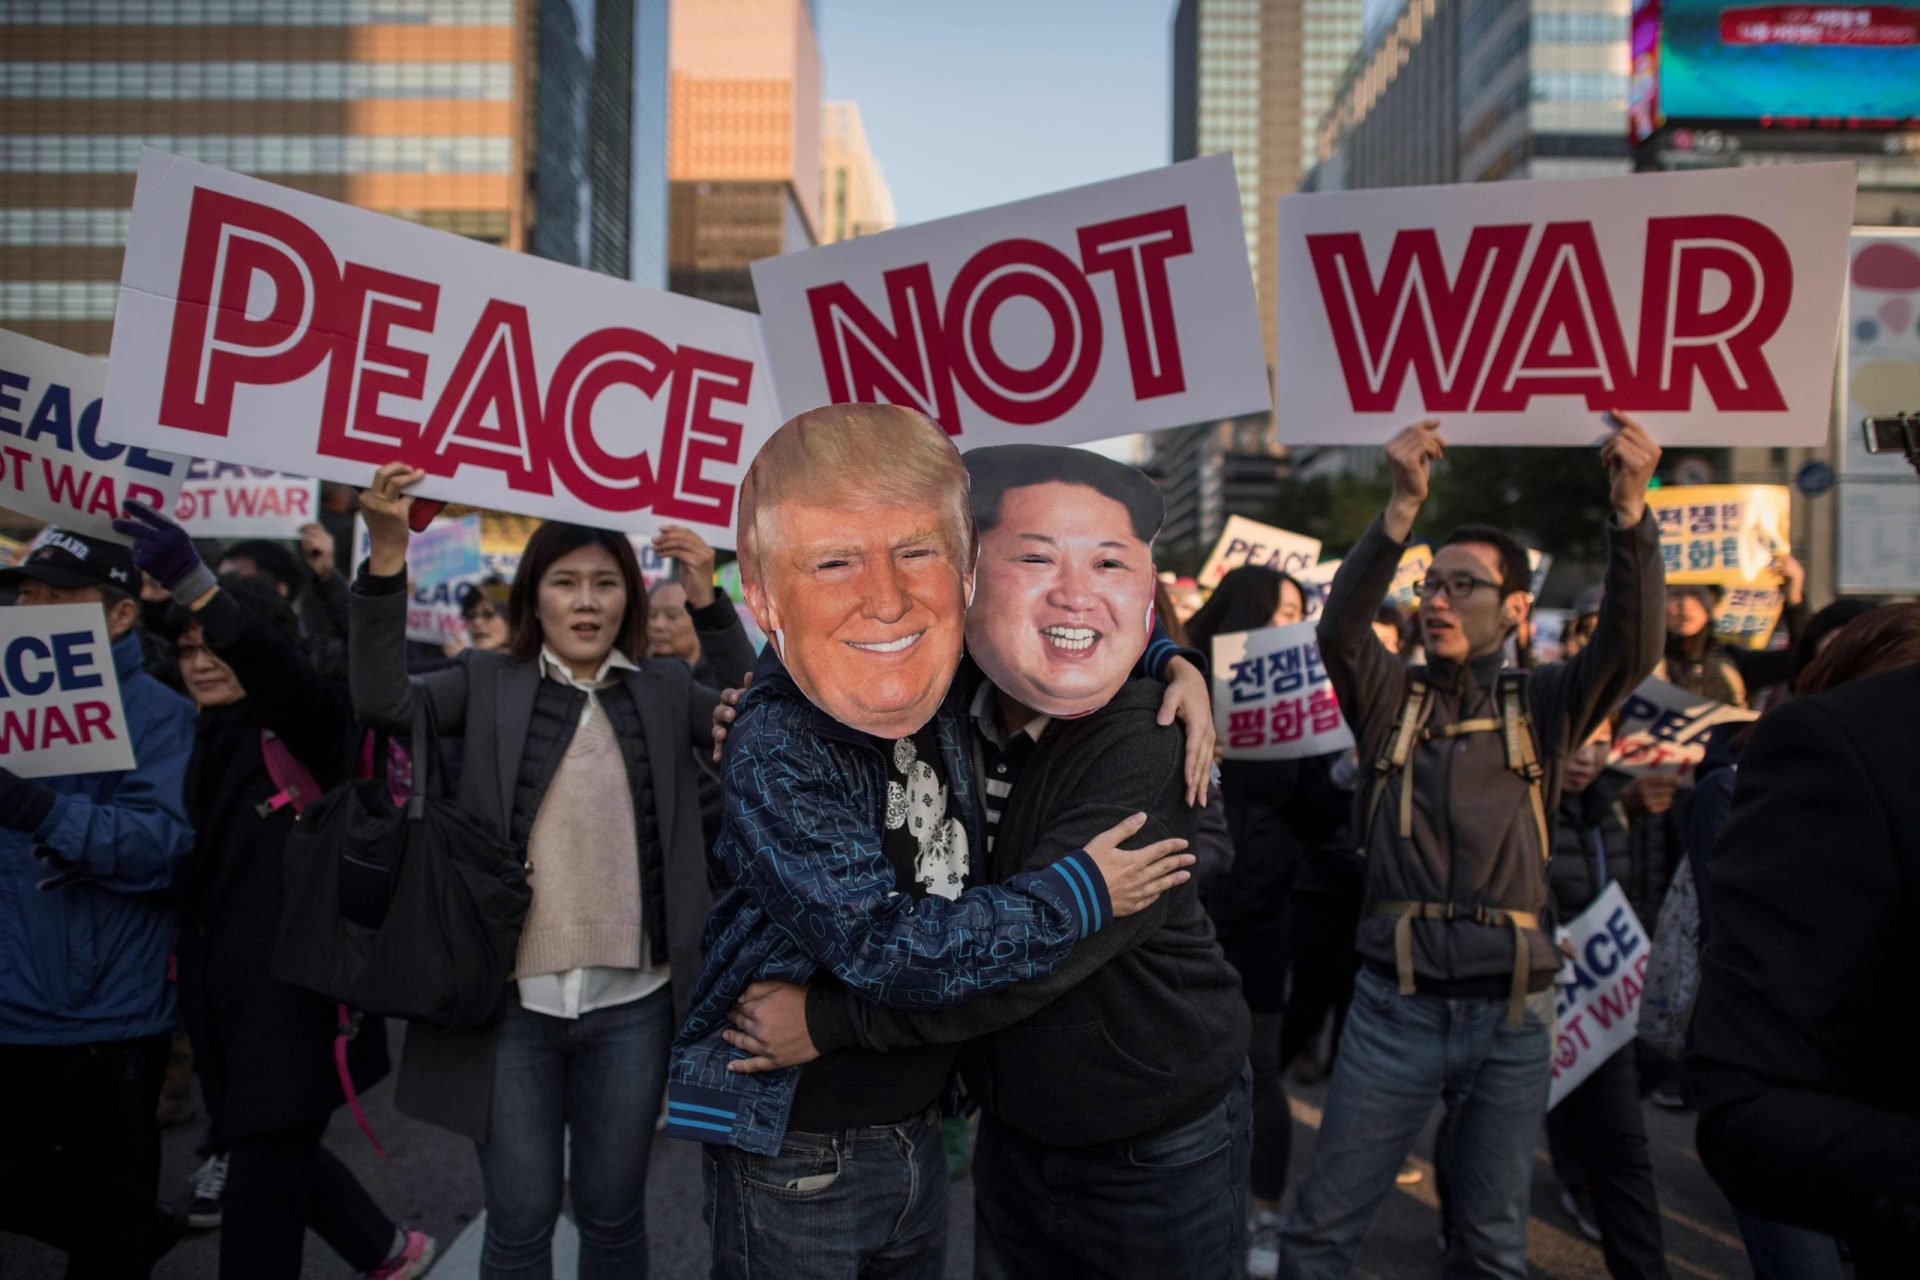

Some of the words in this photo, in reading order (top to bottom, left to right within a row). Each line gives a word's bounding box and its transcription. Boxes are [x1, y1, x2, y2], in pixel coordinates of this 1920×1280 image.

[159, 186, 754, 528] PEACE
[806, 204, 1193, 437] NOT
[1305, 214, 1793, 412] WAR
[42, 457, 164, 519] WAR
[224, 487, 310, 518] WAR
[0, 630, 104, 697] CE
[0, 700, 117, 755] WAR
[1555, 905, 1641, 1018] ACE
